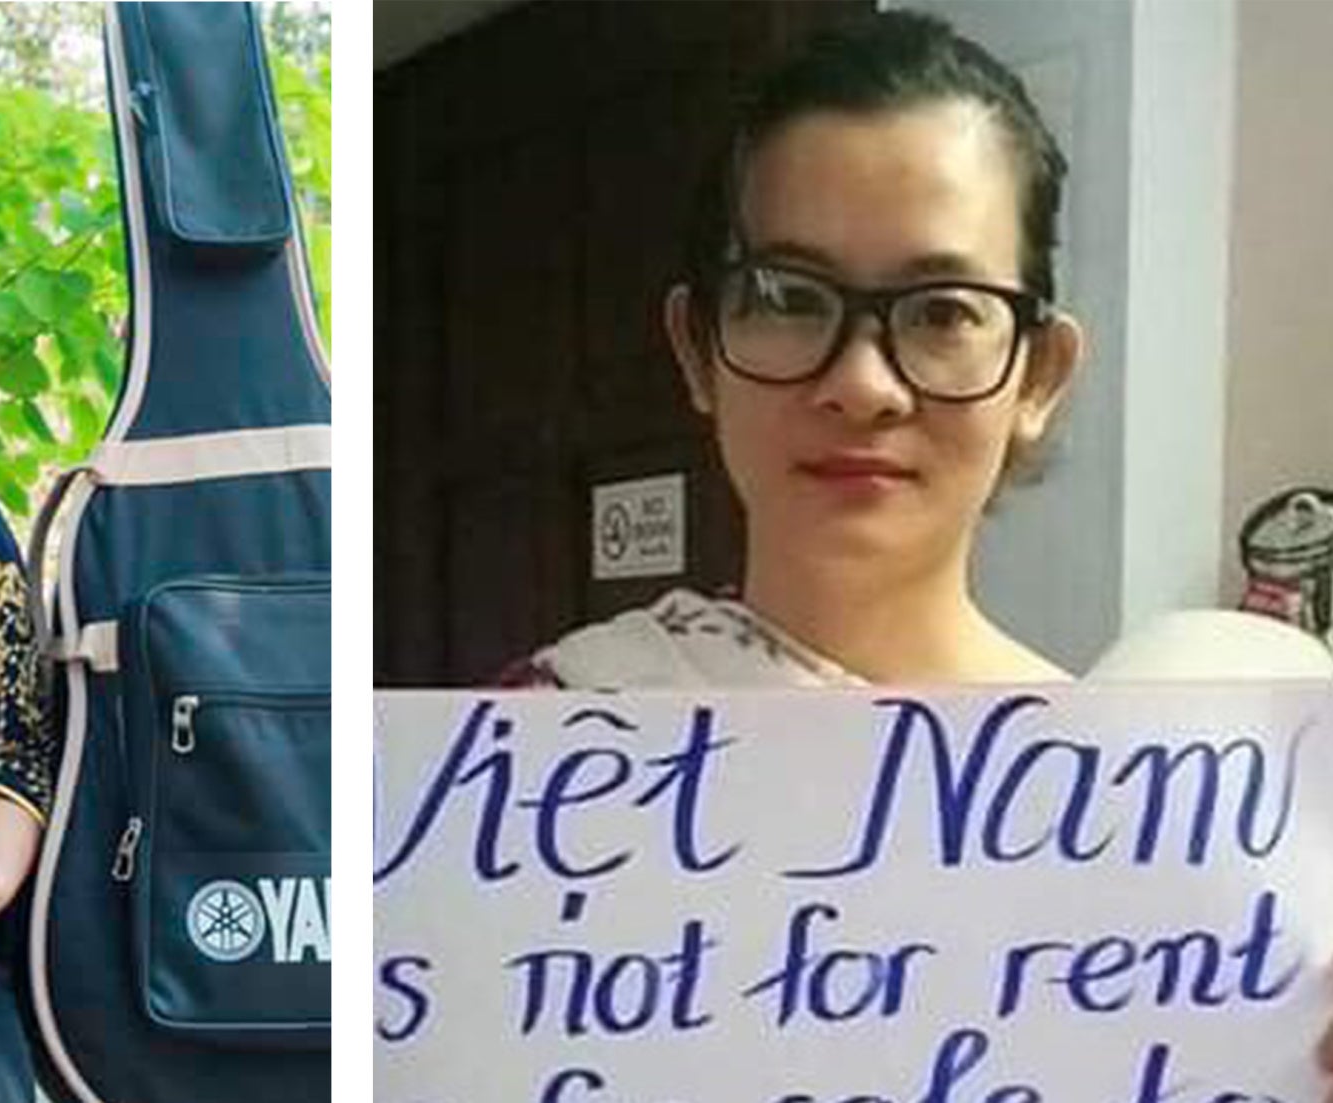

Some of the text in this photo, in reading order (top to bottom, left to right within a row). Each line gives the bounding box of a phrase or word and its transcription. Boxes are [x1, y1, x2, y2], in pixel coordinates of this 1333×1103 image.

[780, 694, 1316, 877] Nam
[257, 877, 331, 963] YA
[503, 918, 715, 1037] not
[741, 903, 937, 1028] for
[996, 891, 1301, 1018] rent
